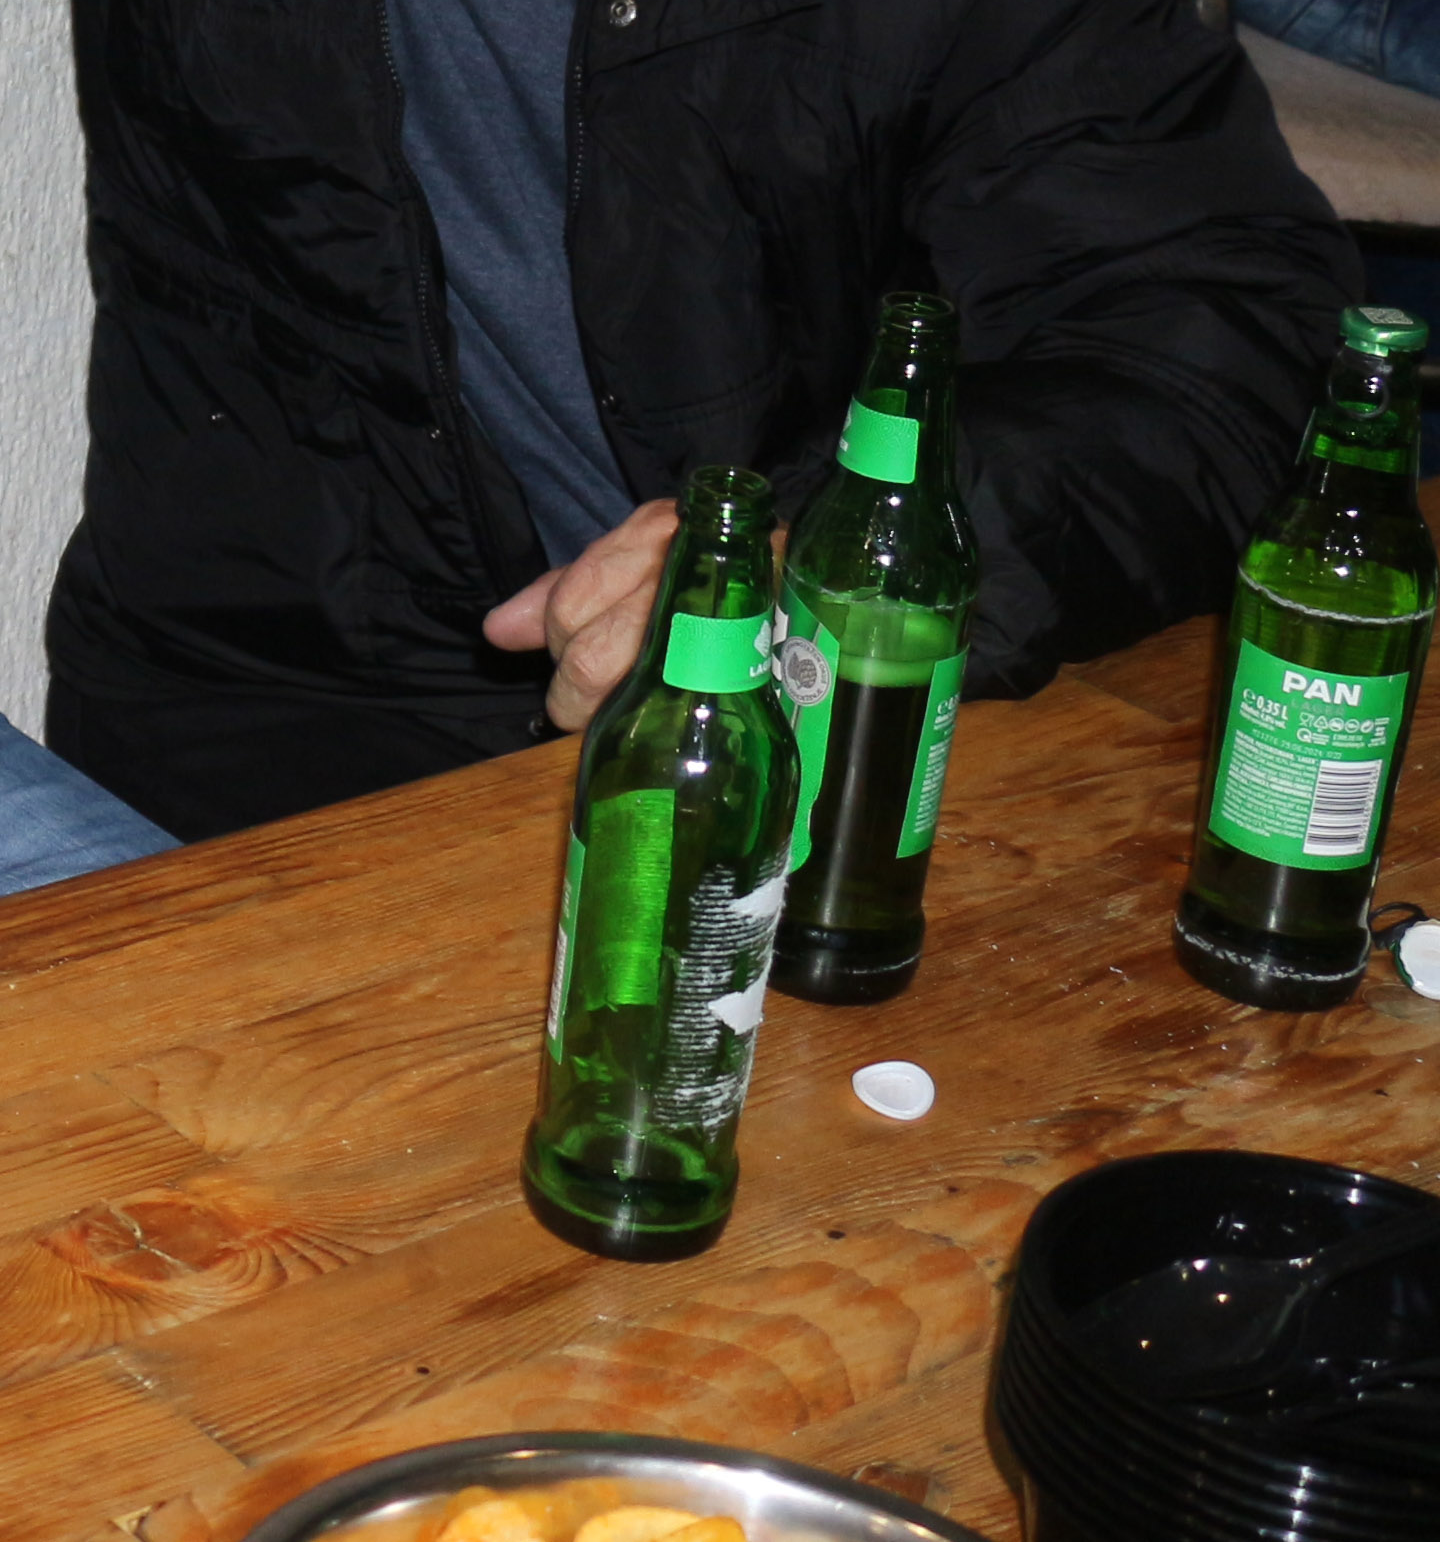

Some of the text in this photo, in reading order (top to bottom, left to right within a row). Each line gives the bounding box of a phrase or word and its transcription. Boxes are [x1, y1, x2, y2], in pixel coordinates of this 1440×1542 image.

[1282, 670, 1363, 707] PAN
[1256, 694, 1281, 716] 0,35
[1281, 705, 1289, 721] L
